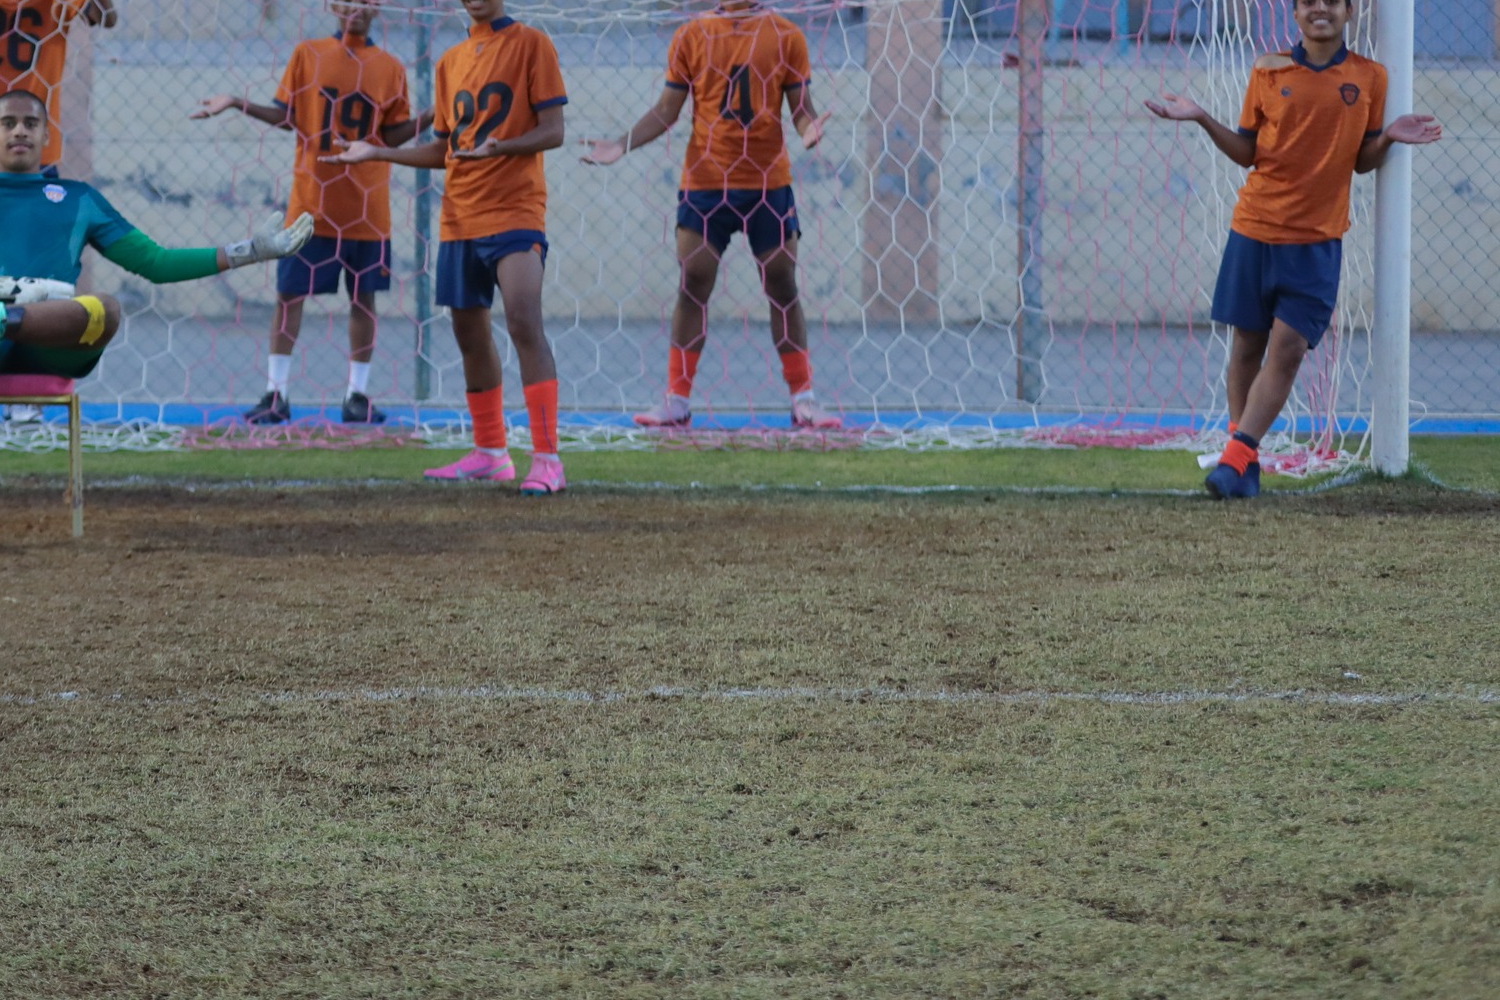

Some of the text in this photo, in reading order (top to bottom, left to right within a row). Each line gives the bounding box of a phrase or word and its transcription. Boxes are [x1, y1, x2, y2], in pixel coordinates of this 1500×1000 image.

[319, 86, 375, 151] 19
[451, 82, 513, 153] 22
[719, 64, 754, 129] 4
